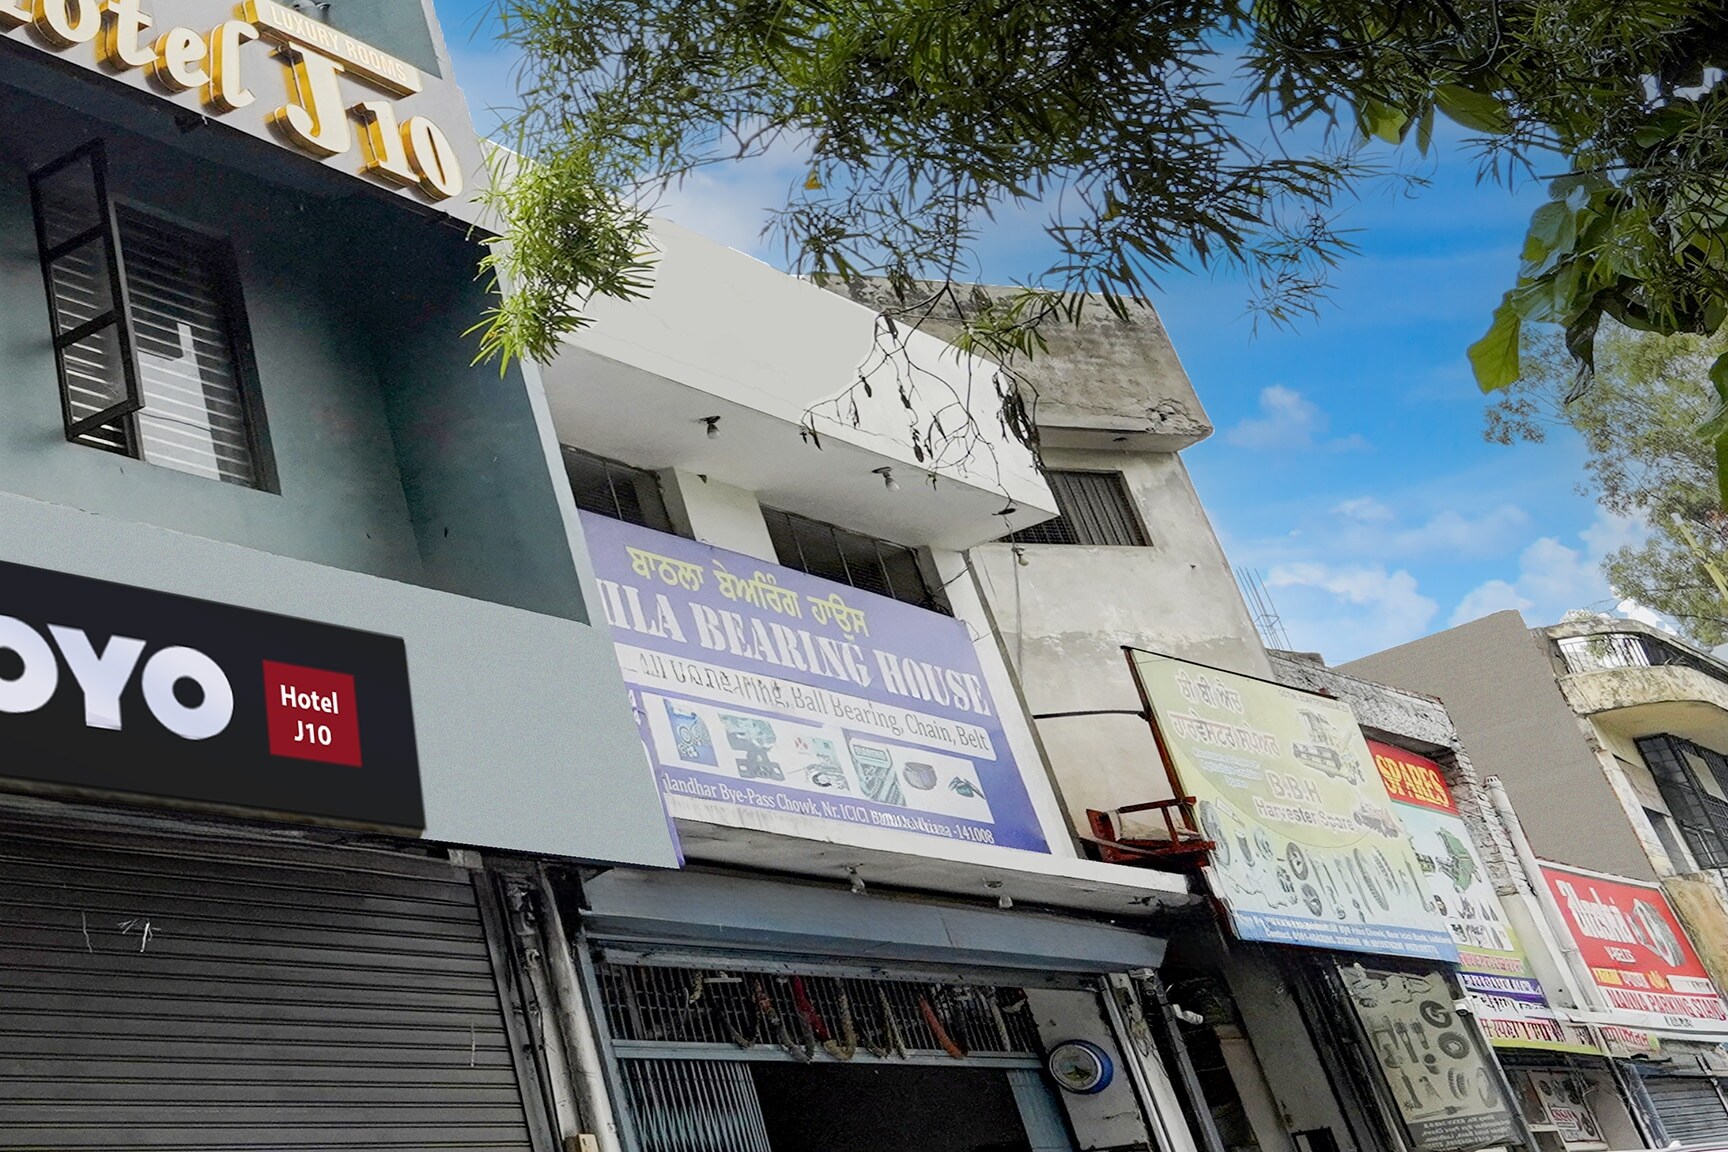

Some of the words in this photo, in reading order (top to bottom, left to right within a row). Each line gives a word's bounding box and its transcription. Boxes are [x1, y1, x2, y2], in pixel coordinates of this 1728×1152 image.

[271, 5, 340, 49] LUXURY
[344, 39, 408, 82] ROOMS
[282, 41, 463, 198] J10
[688, 601, 872, 688] BEARING
[872, 649, 992, 717] HOUSE
[280, 684, 339, 715] Hotel
[791, 686, 829, 715] Ball
[830, 697, 905, 736] Bearing,
[905, 713, 957, 747] Chain,
[957, 725, 990, 751] Belt
[293, 721, 332, 746] J10
[719, 782, 775, 809] Bye-Pass
[776, 793, 822, 818] Chowk,
[1375, 754, 1450, 808] SPARES
[1254, 797, 1318, 825] Harvester
